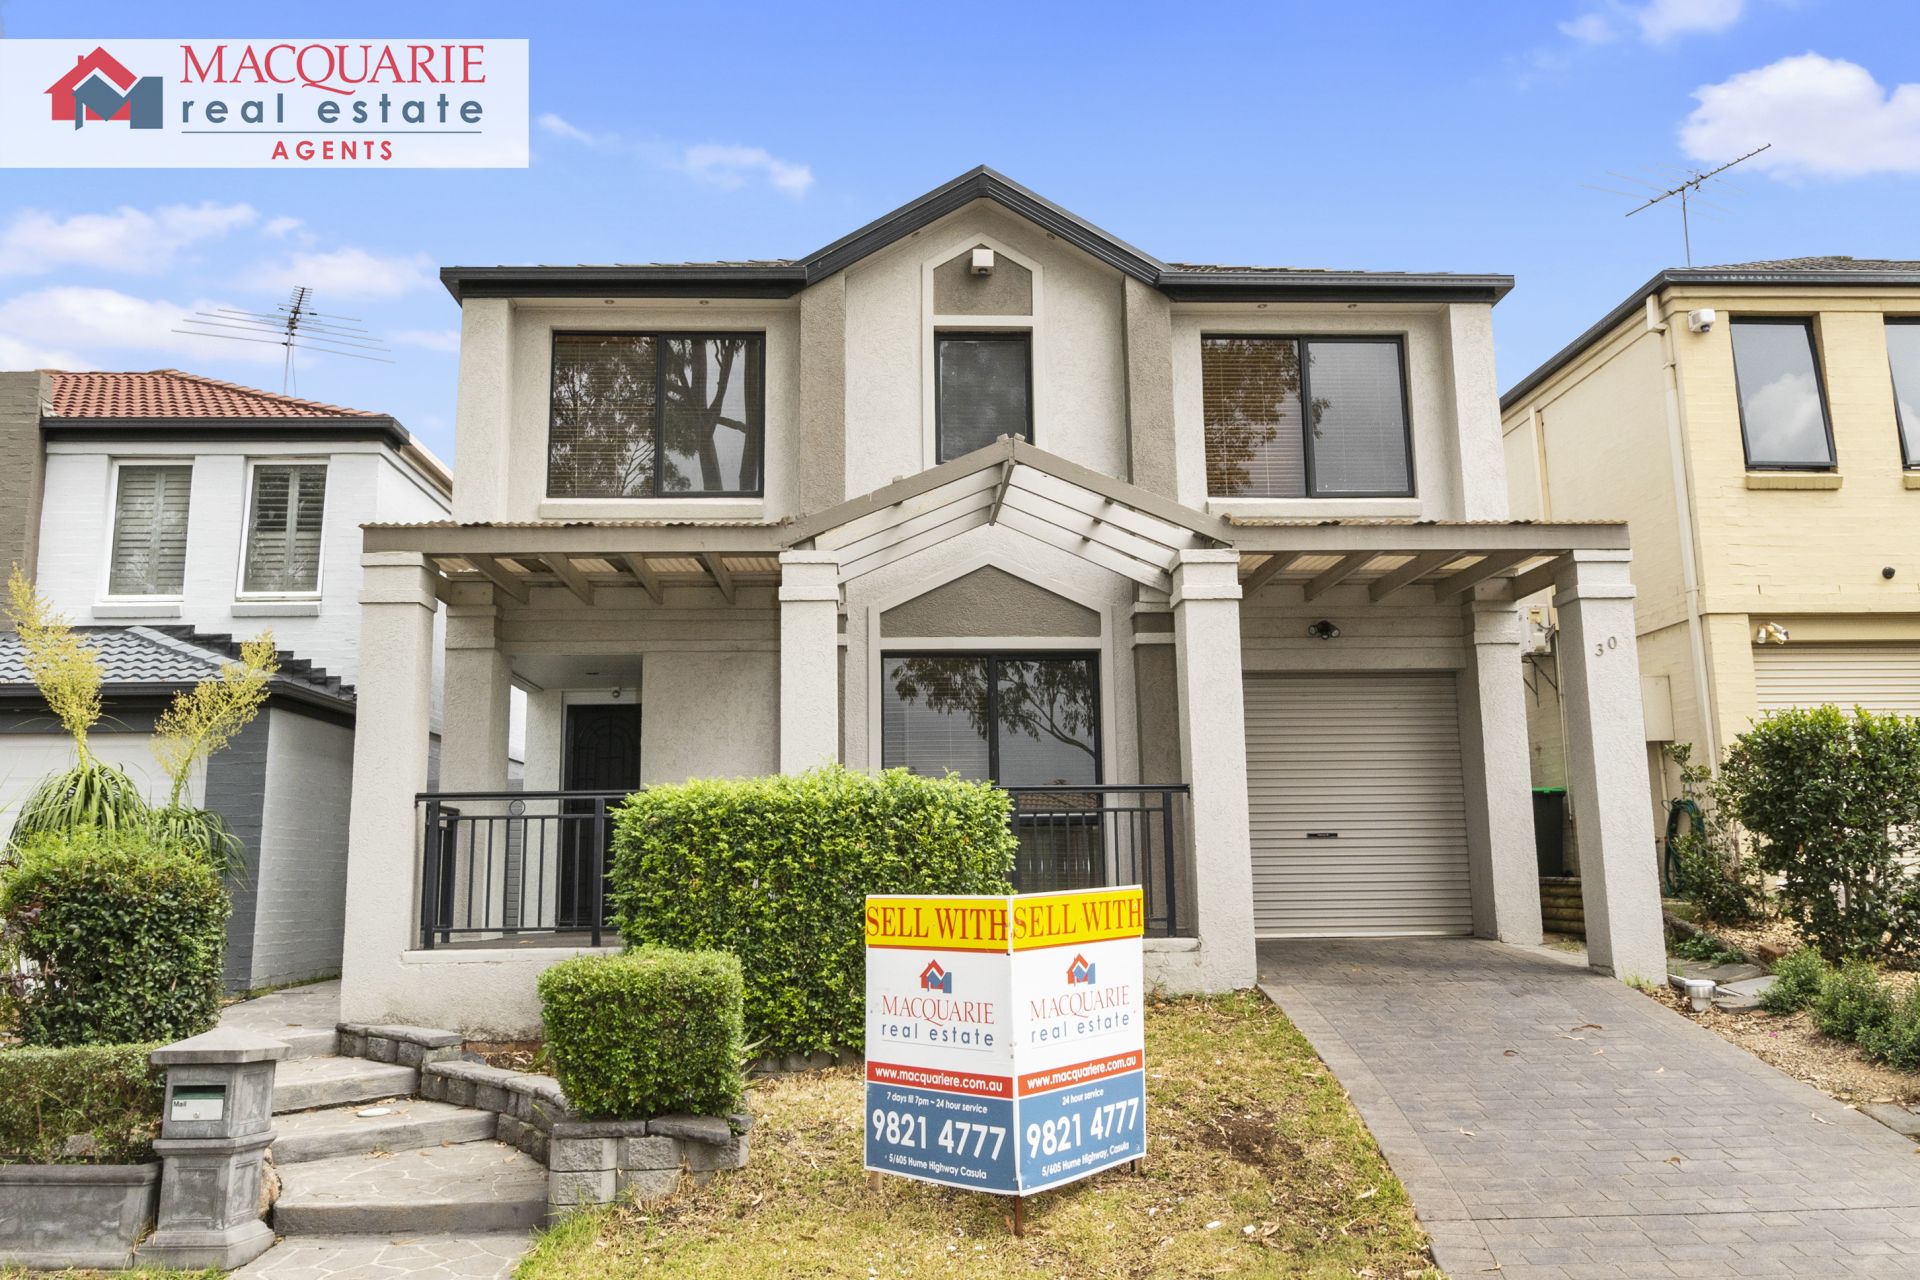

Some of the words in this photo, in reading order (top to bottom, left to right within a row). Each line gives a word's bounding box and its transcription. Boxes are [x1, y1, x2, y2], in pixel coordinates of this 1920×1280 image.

[1595, 636, 1617, 657] 30
[866, 905, 929, 938] SELL
[934, 907, 1008, 941] WITH
[1013, 903, 1076, 940] SELL
[1082, 898, 1143, 933] WITH
[881, 994, 995, 1027] MACQUARIE
[1030, 985, 1130, 1021] MACQUARIE
[881, 1023, 918, 1039] real
[929, 1026, 994, 1046] estate
[1031, 1021, 1067, 1042] real
[1077, 1012, 1129, 1034] estate
[875, 1067, 1002, 1091] www.macquariere.com.au
[1027, 1056, 1136, 1089] www.macquariere.com.au
[886, 1092, 891, 1100] 7
[892, 1093, 907, 1104] days
[915, 1095, 929, 1107] 7pm
[936, 1098, 945, 1108] 24
[945, 1100, 961, 1110] hour
[962, 1104, 988, 1114] service
[1062, 1095, 1070, 1106] 24
[1070, 1093, 1083, 1104] hour
[1084, 1088, 1104, 1100] service
[872, 1108, 927, 1149] 9821
[937, 1119, 1006, 1161] 4777
[1026, 1113, 1081, 1159] 9821
[1090, 1097, 1140, 1140] 4777
[888, 1153, 907, 1166] 5/605
[908, 1157, 928, 1169] Hume
[928, 1160, 959, 1176] Highway
[960, 1166, 987, 1179] Casula
[1041, 1163, 1062, 1177] 5/605
[1062, 1158, 1081, 1171] Hume
[1109, 1141, 1130, 1155] Casula
